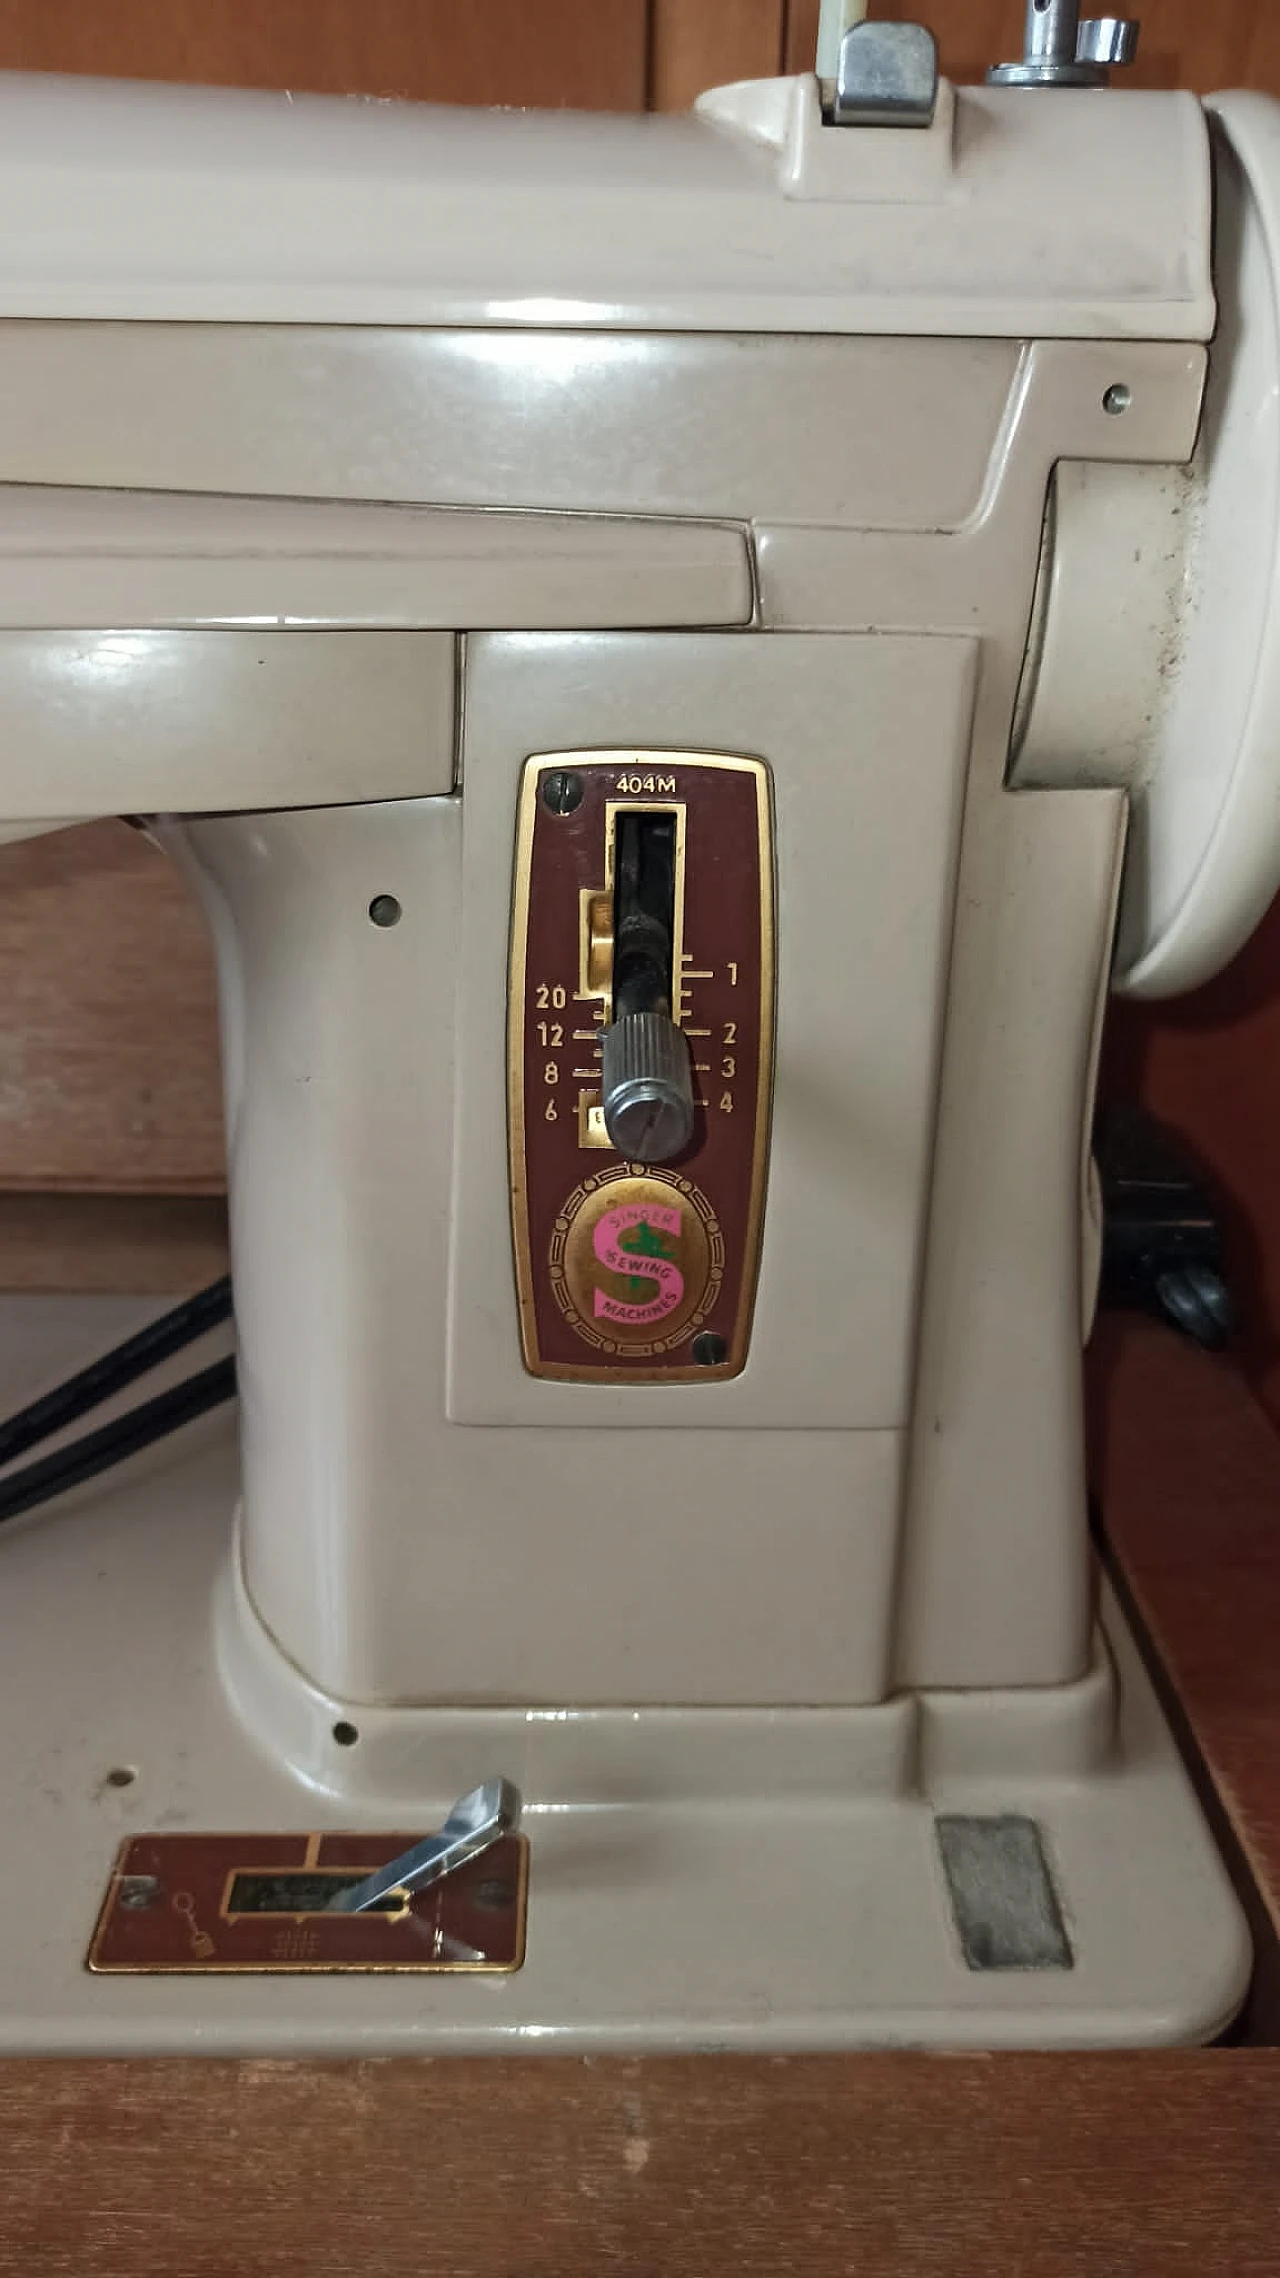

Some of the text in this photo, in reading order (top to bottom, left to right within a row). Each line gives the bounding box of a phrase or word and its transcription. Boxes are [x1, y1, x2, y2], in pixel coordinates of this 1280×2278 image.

[616, 775, 677, 794] 404M
[727, 962, 739, 986] 1
[535, 985, 567, 1010] 20
[537, 1023, 564, 1047] 12
[723, 1023, 738, 1045] 2
[544, 1061, 559, 1085] 8
[721, 1058, 736, 1078] 3
[545, 1099, 558, 1121] 6
[719, 1093, 734, 1113] 4
[609, 1210, 674, 1229] SINGER
[606, 1250, 672, 1279] SEWING
[603, 1292, 677, 1319] MACHINES
